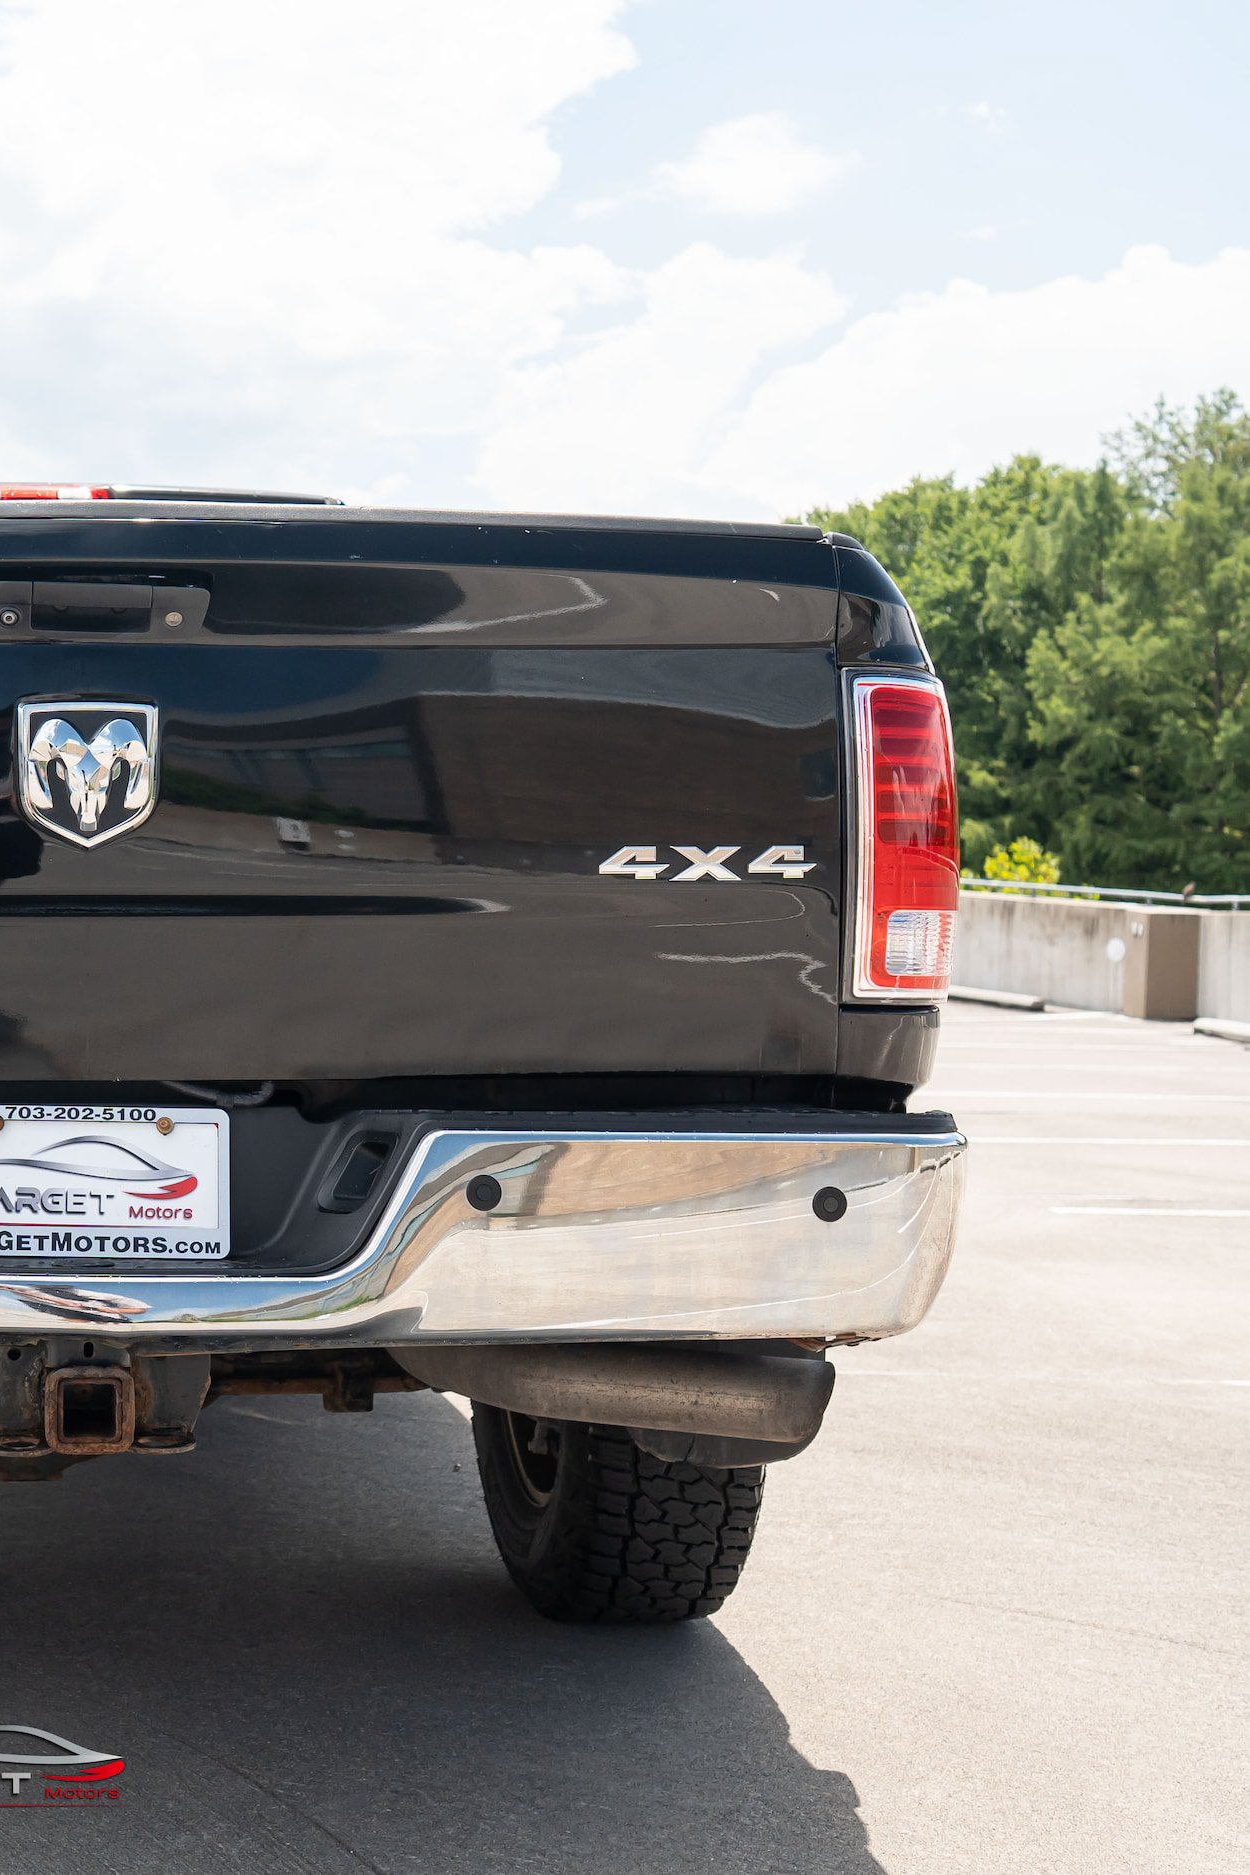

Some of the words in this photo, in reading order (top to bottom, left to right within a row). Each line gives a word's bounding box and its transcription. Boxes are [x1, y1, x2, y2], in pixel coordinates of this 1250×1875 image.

[599, 845, 817, 881] 4X4
[5, 1106, 157, 1121] 703-202-5100
[129, 1206, 193, 1219] Motors
